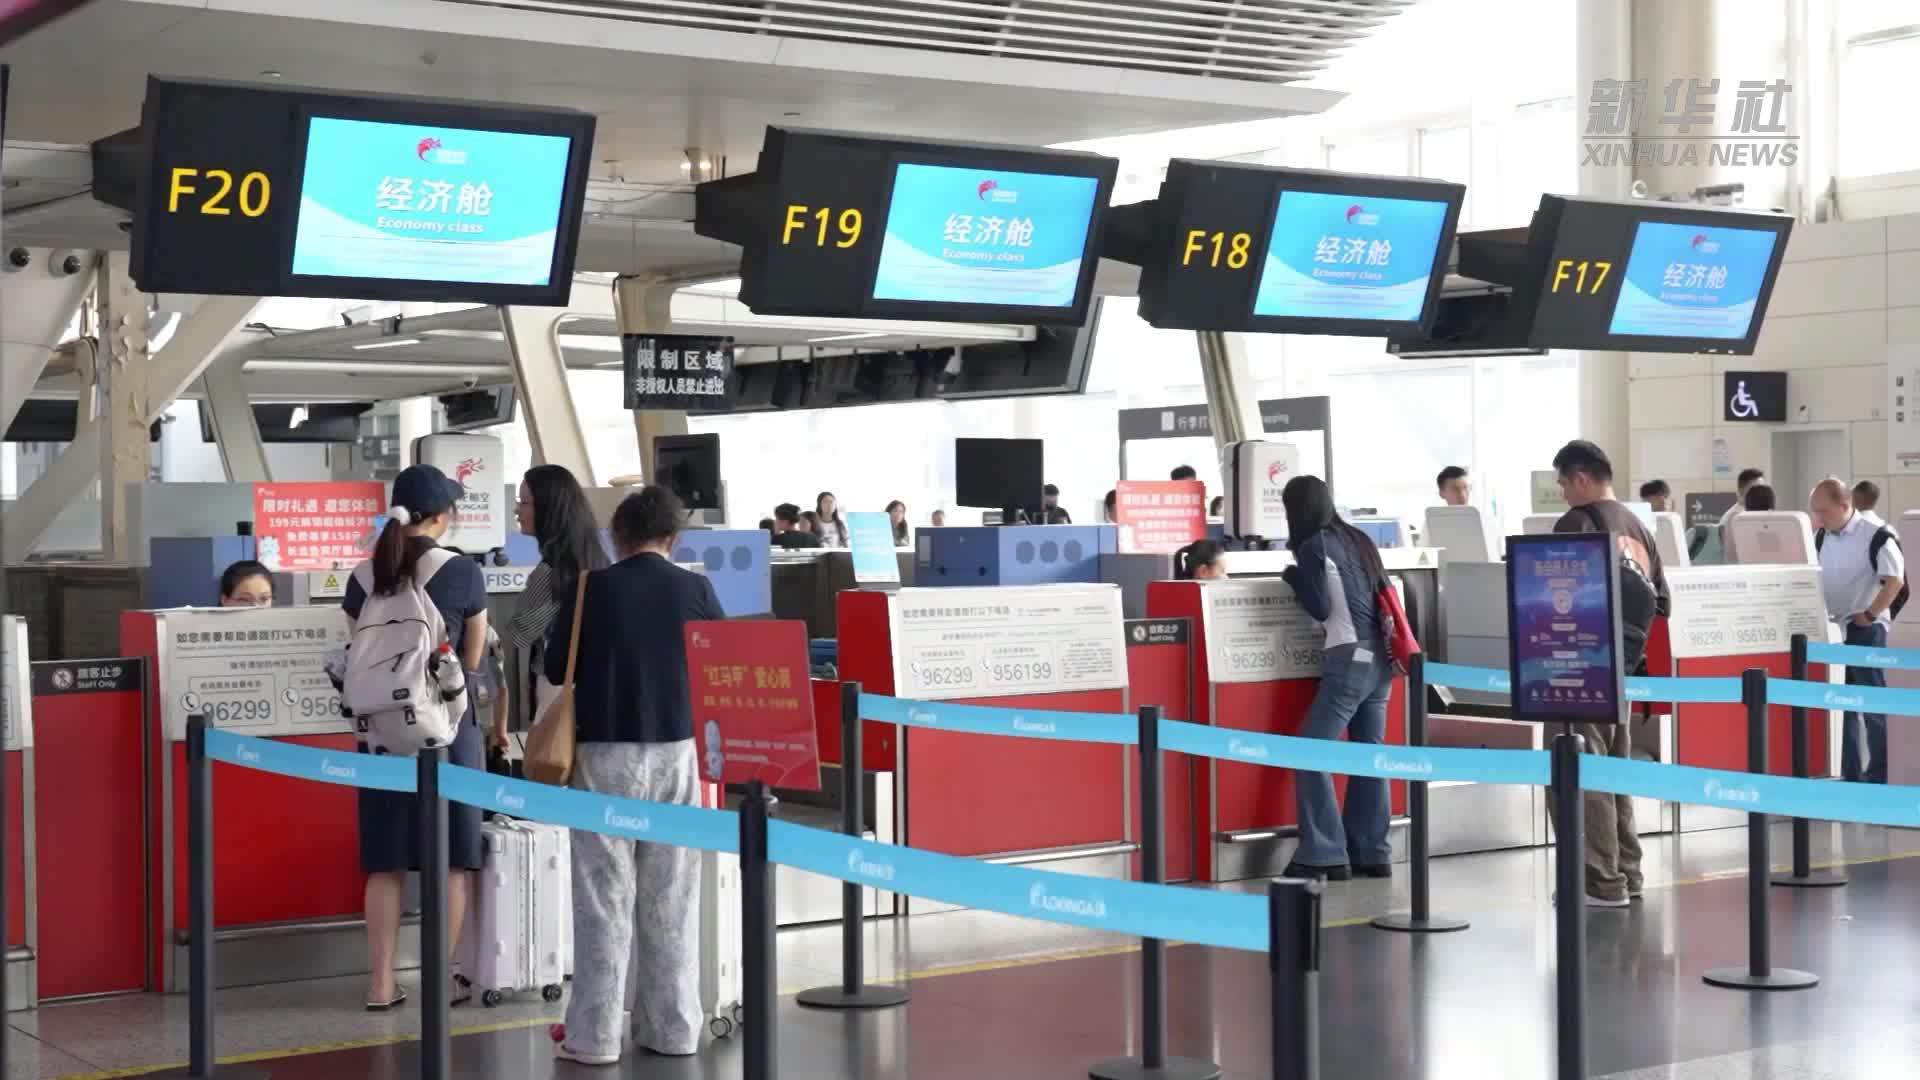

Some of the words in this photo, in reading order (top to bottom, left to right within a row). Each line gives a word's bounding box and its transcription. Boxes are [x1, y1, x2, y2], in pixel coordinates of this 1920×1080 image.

[168, 167, 271, 218] F20
[376, 176, 493, 216] 经济舱
[376, 216, 444, 232] Economy
[447, 220, 484, 233] class
[783, 205, 862, 248] F19
[944, 213, 1034, 247] 经济舱
[1183, 230, 1250, 269] F18
[1313, 236, 1392, 265] 经济舱
[1552, 260, 1612, 294] F17
[1663, 263, 1728, 288] 经济舱
[637, 349, 724, 370] 限制区域
[636, 377, 724, 395] 非授权人员禁止进出
[486, 573, 524, 587] FISC
[176, 627, 327, 644] 如您需要帮助请拨打以下电话
[1232, 651, 1275, 669] 96299
[1293, 650, 1320, 666] 956
[922, 665, 973, 686] 96299
[993, 662, 1052, 681] 956199
[201, 699, 272, 722] 96299
[300, 695, 342, 718] 956
